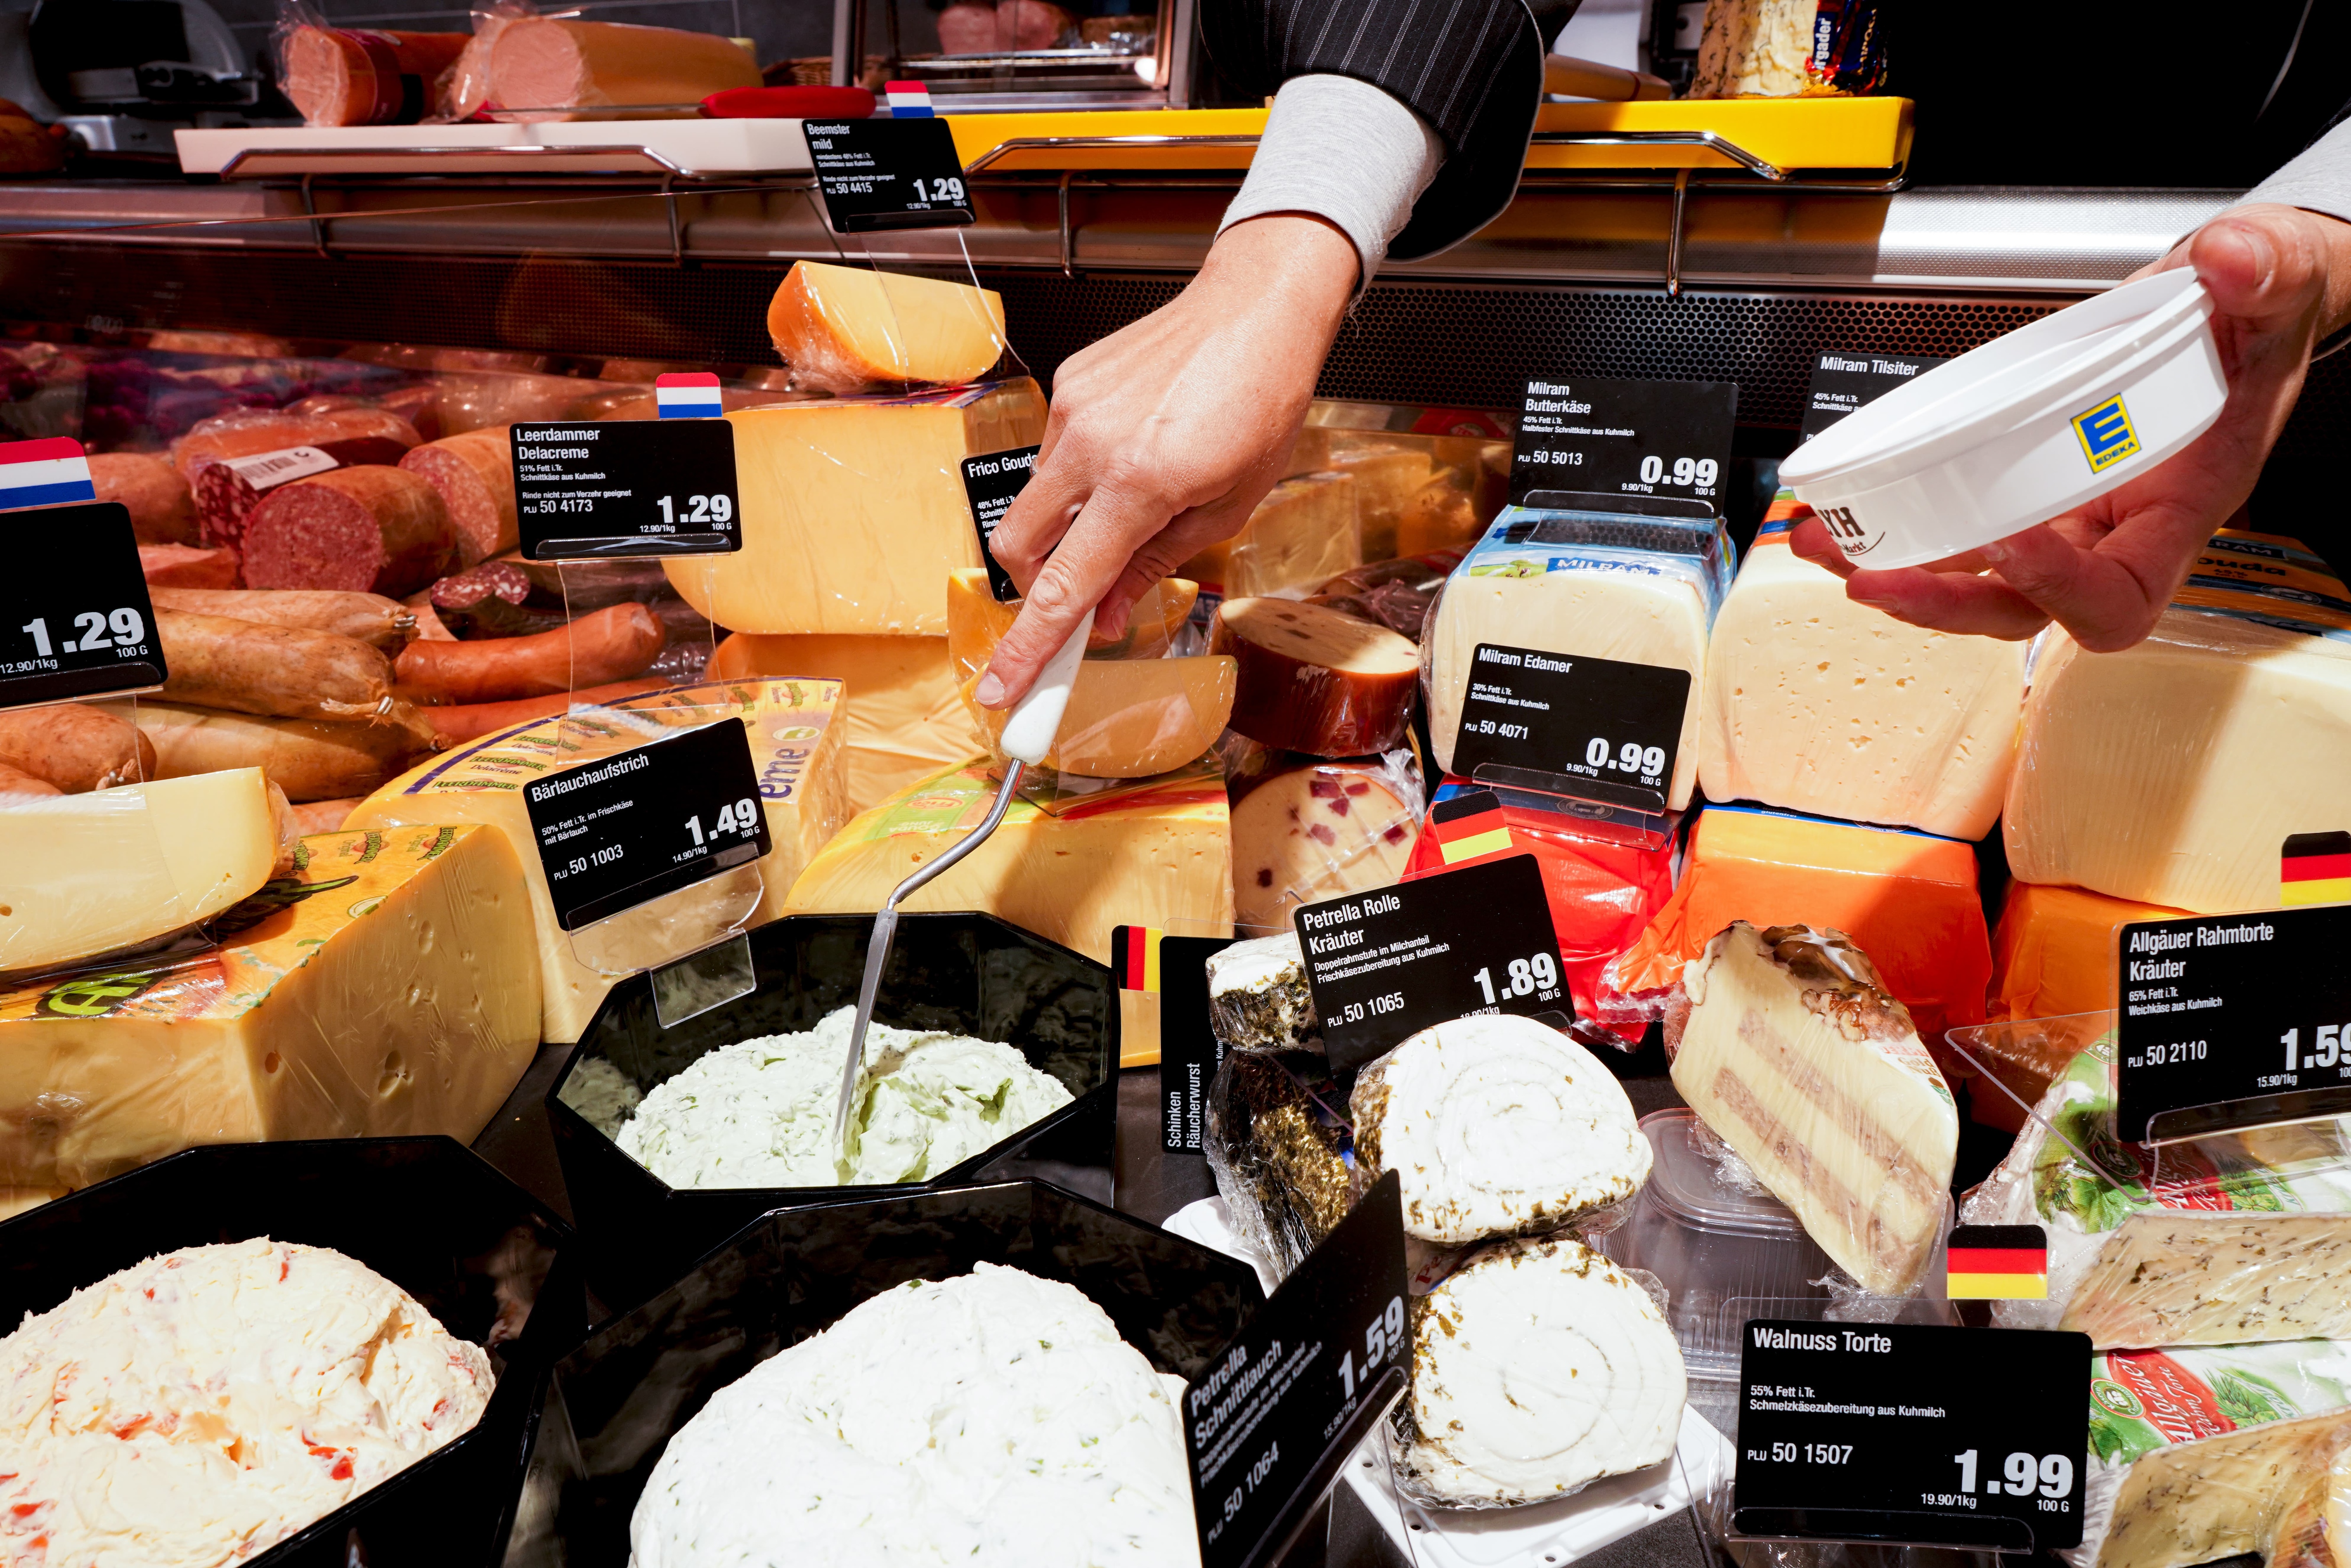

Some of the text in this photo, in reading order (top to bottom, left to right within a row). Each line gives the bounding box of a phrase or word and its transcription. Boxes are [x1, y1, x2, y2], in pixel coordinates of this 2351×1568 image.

[806, 123, 850, 135] Beemster
[812, 138, 833, 150] mild
[836, 183, 849, 194] 50
[850, 182, 873, 193] 4415
[913, 177, 964, 202] 1.29
[1820, 356, 1919, 376] Milram Tilsiter
[1528, 381, 1570, 395] Milram
[1525, 398, 1591, 414] Butterkäse
[1812, 401, 1853, 412] Schnittkäse
[1831, 394, 1846, 402] Fett
[516, 428, 600, 441] Leerdammer
[1522, 424, 1554, 433] Halbfester
[1554, 425, 1591, 434] Schnittkäse
[1604, 428, 1635, 436] Kuhmilch
[518, 446, 589, 459] Delacreme
[1533, 450, 1549, 464] 50
[1551, 451, 1583, 465] 5013
[2096, 441, 2135, 466] EDEKA
[521, 473, 560, 481] Schnittkäse
[968, 462, 999, 478] Frico
[1640, 456, 1718, 487] 0.99
[603, 489, 632, 498] geeignet
[1621, 483, 1653, 494] 9.90/1kg
[1695, 487, 1709, 496] 100
[540, 500, 556, 513] 50
[560, 499, 593, 512] 4173
[657, 494, 732, 523] 1.29
[978, 497, 1005, 509] 48% Fett
[639, 524, 676, 533] 12.90/1kg
[1557, 559, 1650, 575] MILRAM
[22, 607, 144, 657] 1.29
[116, 645, 148, 658] 100 G
[0, 658, 58, 674] 12.90/1kg
[1479, 648, 1573, 673] Milram Edamer
[1472, 683, 1512, 695] 30% Fett i.Tr.
[1471, 692, 1507, 704] Schnittkäse
[1520, 699, 1550, 710] Kuhmilch
[1465, 720, 1528, 740] PLU 50 4071
[470, 756, 549, 771] LEERDAMMER
[1586, 737, 1665, 776] 0.99
[471, 764, 522, 775] Delacrème
[531, 753, 649, 802] Bärlauchaufstrich
[1566, 763, 1598, 777] 9.90/1kg
[433, 781, 519, 790] LEERDAMMER
[1640, 775, 1654, 785] 100
[542, 824, 559, 836] 50%
[559, 819, 574, 830] Fett
[574, 815, 587, 825] i.Tr.
[597, 800, 633, 817] Frischkäse
[685, 798, 757, 846] 1.49
[544, 825, 588, 845] mit Bärlauch
[740, 828, 753, 838] 100
[553, 844, 623, 881] PLU 50 1003
[672, 846, 708, 863] 14.90/1kg
[1303, 894, 1400, 931] Petrella Rolle
[1309, 929, 1364, 955] Kräuter
[2129, 922, 2274, 955] Allgäuer Rahmtorte
[1314, 935, 1429, 973] Doppelrahmstufe im Milchanteil
[1317, 943, 1450, 984] Frischkäsezubereitung aus Kuhmilch
[2130, 959, 2186, 982] Kräuter
[1473, 952, 1557, 1005] 1.89
[1538, 988, 1561, 1002] 100 G
[2129, 986, 2178, 1002] 65% Fett i.Tr.
[1327, 992, 1404, 1027] PLU 50 1065
[2129, 996, 2223, 1016] Weichkäse aus Kuhmilch
[2128, 1040, 2207, 1068] PLU 50 2110
[2256, 1073, 2297, 1087] 15.90/1kg
[1186, 1063, 1200, 1148] Räucherwurst
[1168, 1091, 1182, 1147] Schinken
[1338, 1296, 1405, 1399] 1.59
[1753, 1327, 1892, 1353] Walnuss Torte
[1191, 1345, 1247, 1417] Petrella
[1195, 1340, 1282, 1449] Schnittlauch
[1751, 1385, 1815, 1398] 55% Fett i.Tr.
[1750, 1399, 1946, 1418] Schmelzkäsezubereitung aus Kuhmilch
[1747, 1442, 1853, 1464] PLU 50 1507
[1224, 1441, 1279, 1522] 50 1064
[1954, 1449, 2073, 1498] 1.99
[1921, 1493, 1977, 1509] 19.90/1kg
[2037, 1499, 2069, 1513] 100 G
